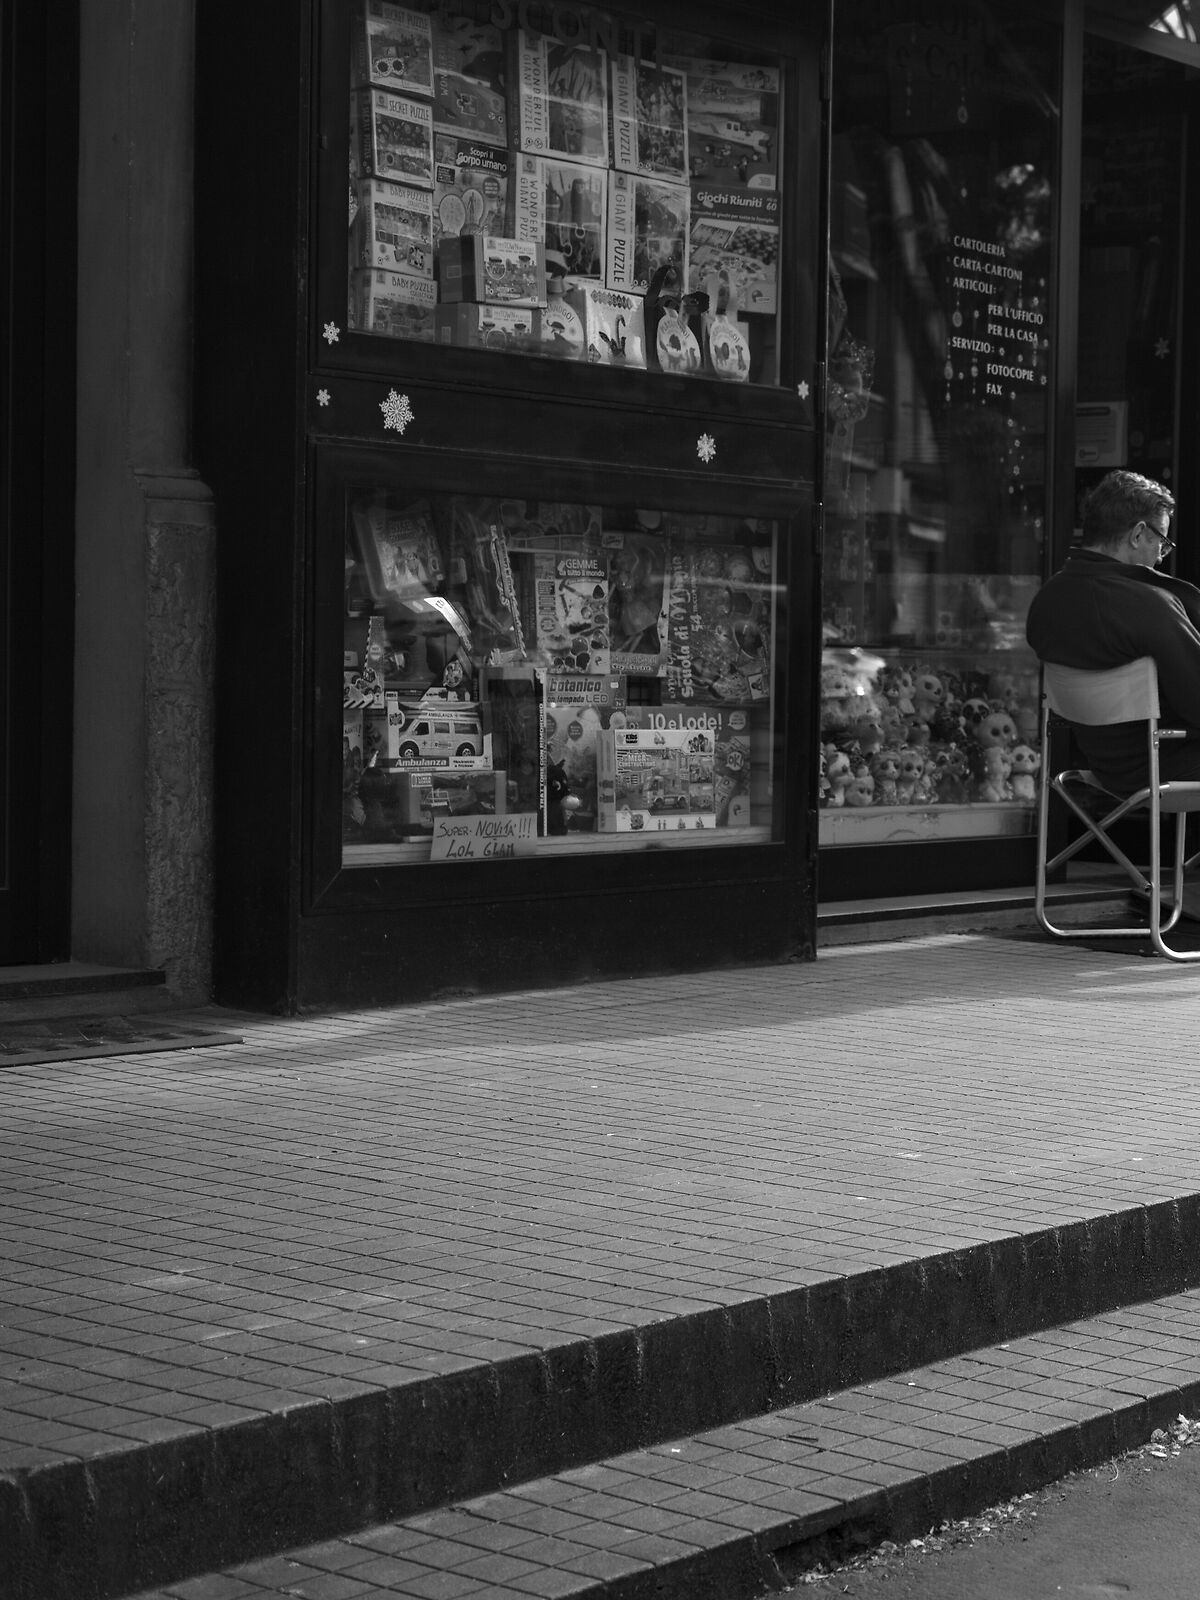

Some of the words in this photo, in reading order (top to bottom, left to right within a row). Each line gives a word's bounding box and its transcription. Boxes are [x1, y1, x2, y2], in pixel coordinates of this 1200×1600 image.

[532, 56, 542, 132] WONDERFUL
[617, 76, 629, 117] GIANT
[389, 100, 408, 116] SECRET
[410, 104, 430, 120] PUZZLE
[525, 93, 533, 132] PUZZLE
[618, 119, 631, 165] PUZZLE
[470, 147, 488, 158] Scopri
[482, 159, 507, 172] umano
[390, 183, 406, 198] BABY
[406, 188, 430, 203] PUZZLE
[520, 177, 529, 210] GIANT
[697, 192, 728, 204] Giochi
[730, 195, 763, 208] Riuniti
[614, 194, 626, 232] GIANT
[766, 202, 777, 212] 60
[954, 235, 1006, 258] CARTOLERIA
[613, 238, 626, 284] PUZZLE
[953, 256, 1022, 280] CARTA-CARTONI
[391, 276, 410, 290] BABY
[410, 279, 434, 295] PUZZLE
[953, 277, 996, 295] ARTICOLI:
[988, 304, 1002, 316] PER
[1005, 307, 1044, 325] L'UFFICIO
[988, 323, 1002, 336] PER
[1004, 327, 1015, 339] LA
[1017, 329, 1038, 342] CASA
[952, 336, 994, 354] SERVIZIO:
[987, 363, 1034, 381] FOTOCOPIE
[986, 383, 1002, 396] FAX
[566, 558, 598, 570] GEMME
[674, 626, 688, 641] di
[676, 646, 694, 698] Scuola
[550, 678, 602, 692] botanico
[586, 694, 608, 704] LED
[648, 713, 666, 730] 10
[668, 720, 676, 730] e
[678, 712, 722, 730] Lode!
[395, 758, 447, 767] Ambulanza
[446, 840, 474, 858] LOL
[483, 842, 515, 857] GLAM
